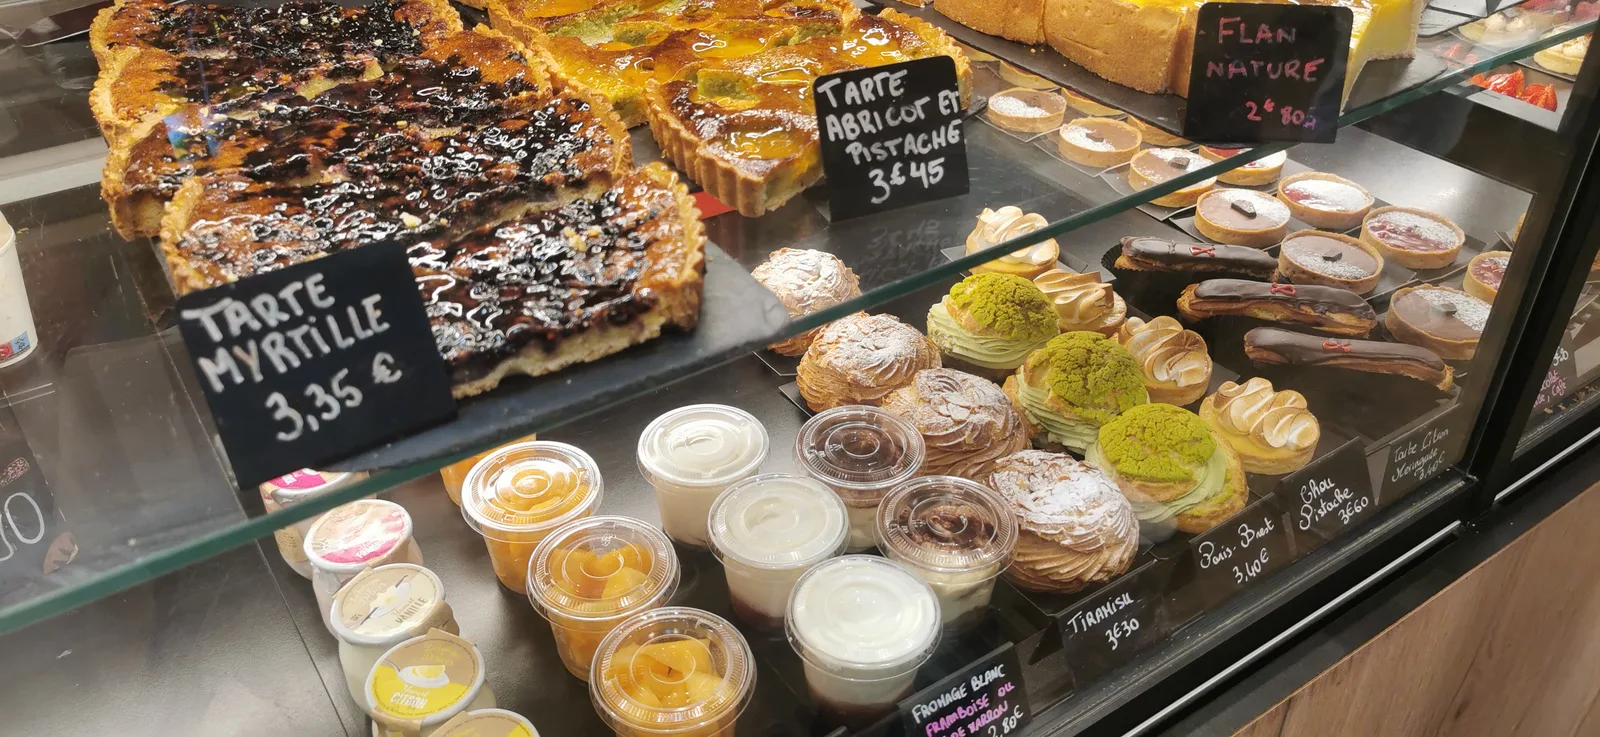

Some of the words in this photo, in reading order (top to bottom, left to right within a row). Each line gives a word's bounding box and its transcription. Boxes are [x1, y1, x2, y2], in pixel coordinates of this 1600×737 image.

[1218, 16, 1297, 44] FLAN
[817, 69, 908, 108] TARTE
[1206, 57, 1325, 82] NATURE
[825, 96, 931, 142] ABRICOT
[938, 89, 960, 116] ET
[845, 119, 962, 165] PISTACHE
[181, 272, 336, 343] TARTE
[265, 368, 364, 441] 3,35
[371, 352, 403, 384] €
[1394, 441, 1418, 463] Tarte
[1299, 488, 1354, 531] Pistache
[1300, 478, 1336, 504] Chou
[1066, 592, 1134, 633] TIRAMISU
[911, 682, 968, 724] FROMAGE
[970, 663, 1006, 692] BLANC
[925, 693, 990, 737] FRAMBOISE
[997, 682, 1016, 697] OU
